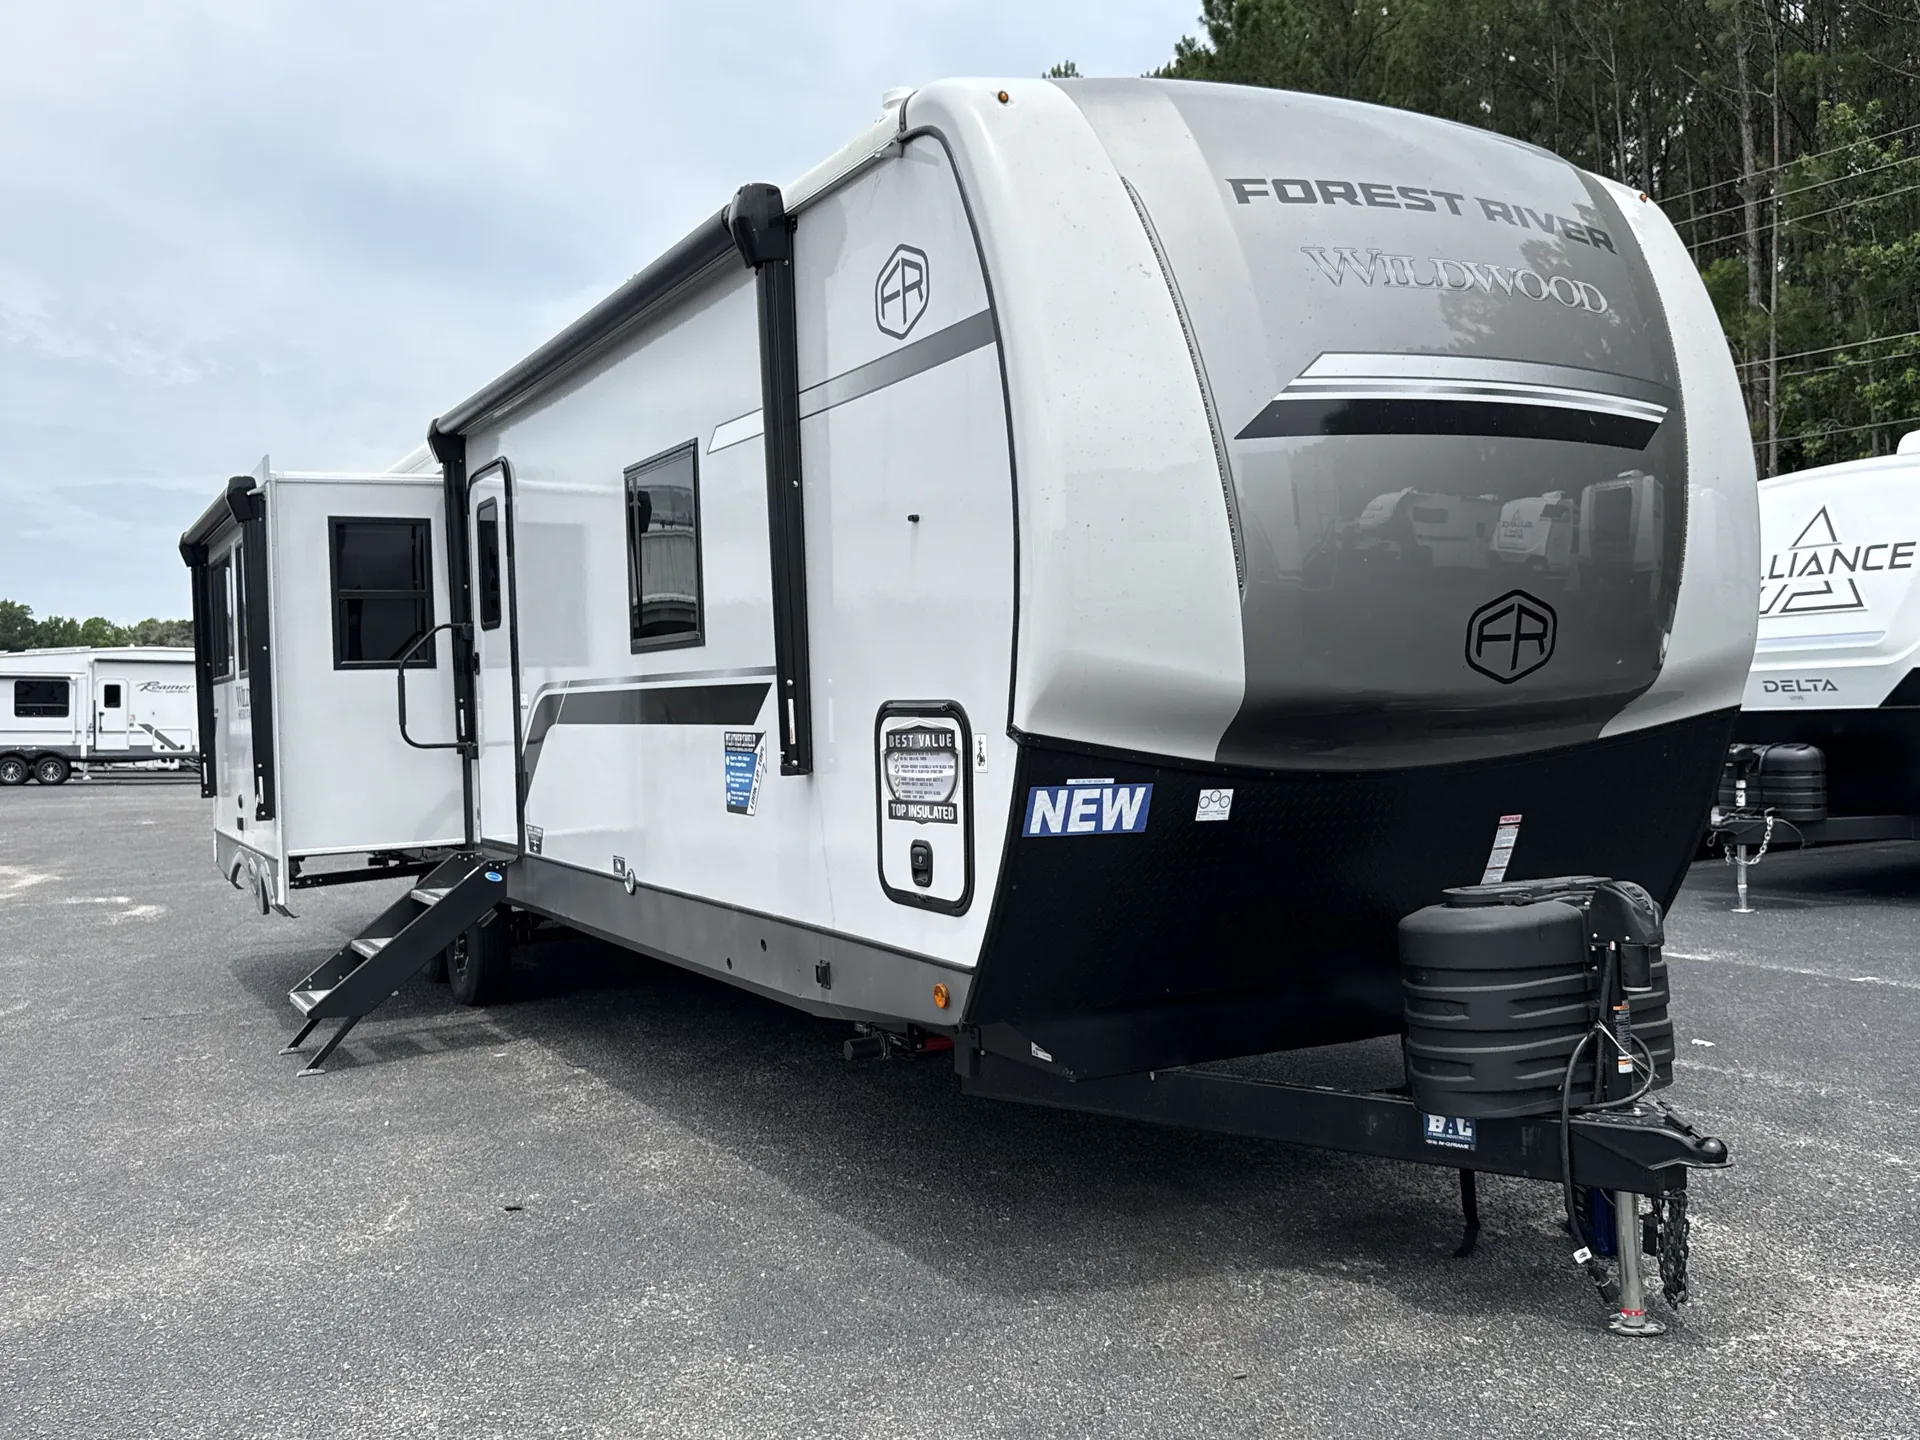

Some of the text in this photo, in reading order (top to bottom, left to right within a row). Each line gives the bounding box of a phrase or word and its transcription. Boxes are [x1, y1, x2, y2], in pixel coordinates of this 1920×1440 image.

[1225, 178, 1618, 255] FOREST RIVER
[1300, 247, 1609, 314] WILDWOOD
[1761, 541, 1917, 580] LIANCE
[136, 681, 194, 692] Roamer
[1762, 679, 1838, 692] DELTA
[888, 733, 952, 748] BEST VALUE
[891, 803, 955, 820] TOP INSULATED
[1029, 787, 1147, 834] NEW
[1428, 1113, 1473, 1137] BAL
